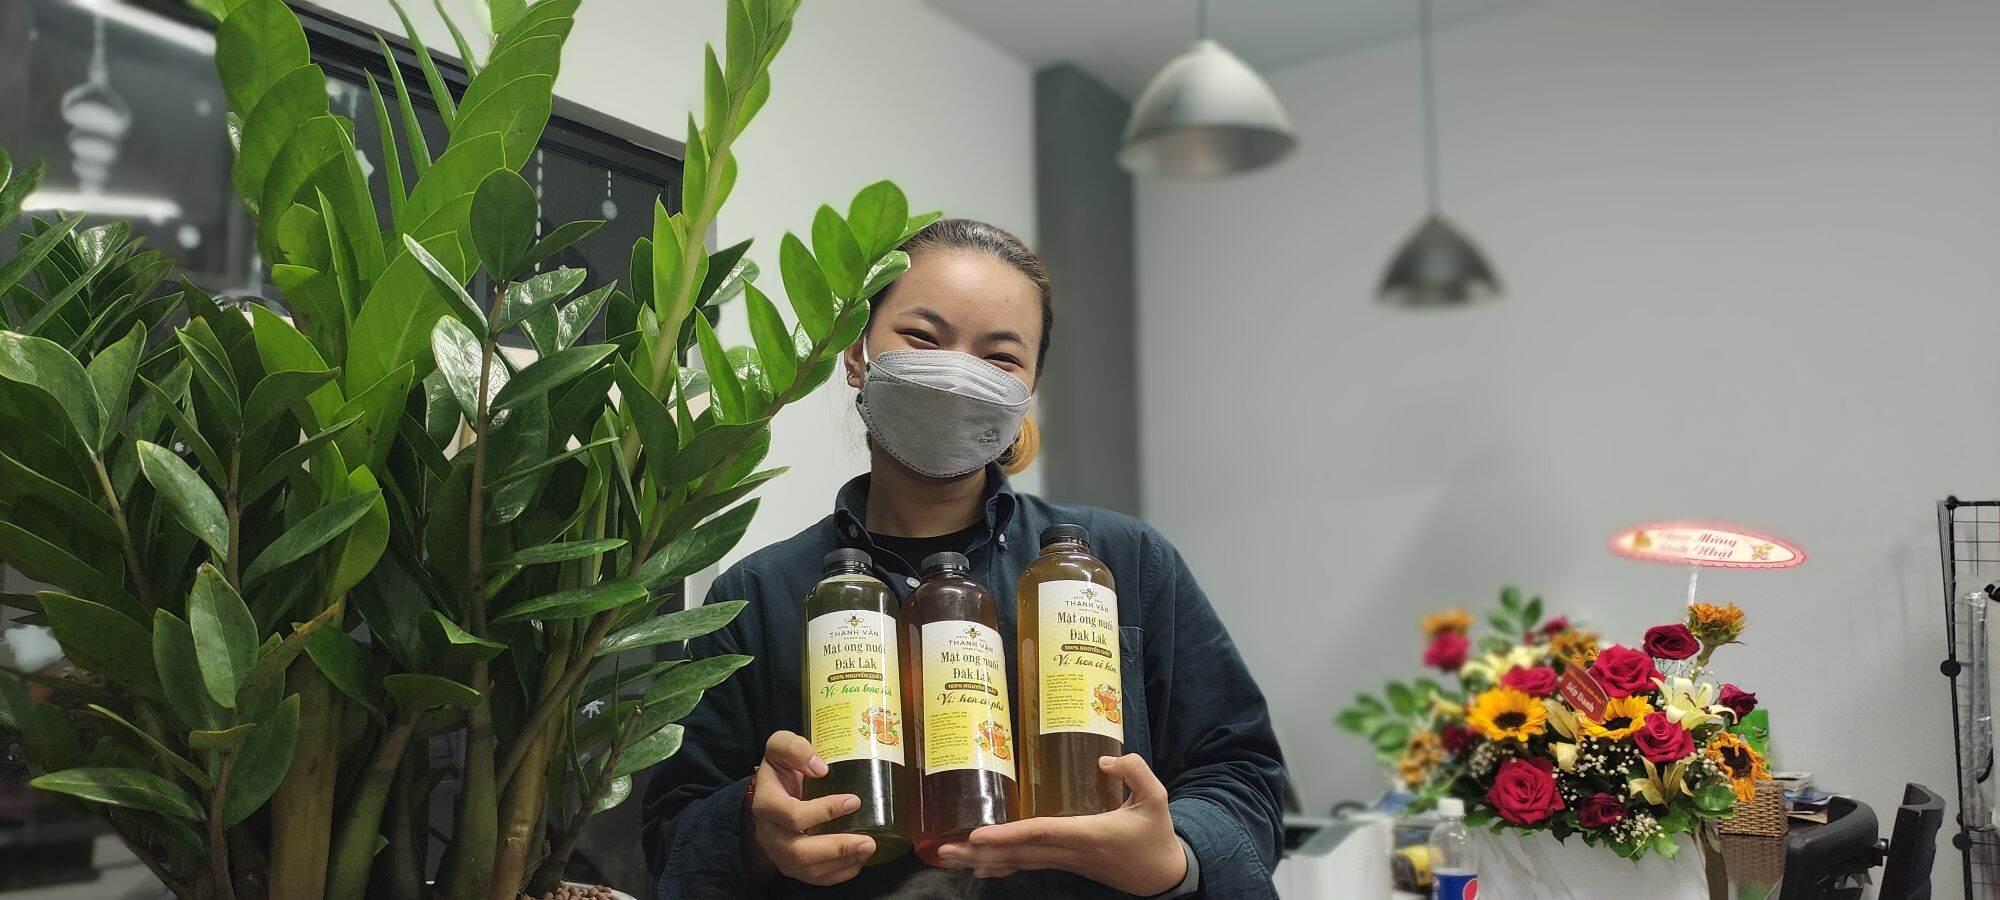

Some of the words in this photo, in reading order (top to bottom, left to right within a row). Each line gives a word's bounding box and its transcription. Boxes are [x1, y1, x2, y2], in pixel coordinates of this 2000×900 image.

[1065, 600, 1094, 609] THANH
[1080, 615, 1097, 628] ong
[829, 630, 859, 638] THANH
[844, 642, 863, 653] ong
[948, 640, 978, 648] THANH
[962, 653, 980, 666] ong
[1577, 692, 1595, 713] Danh
